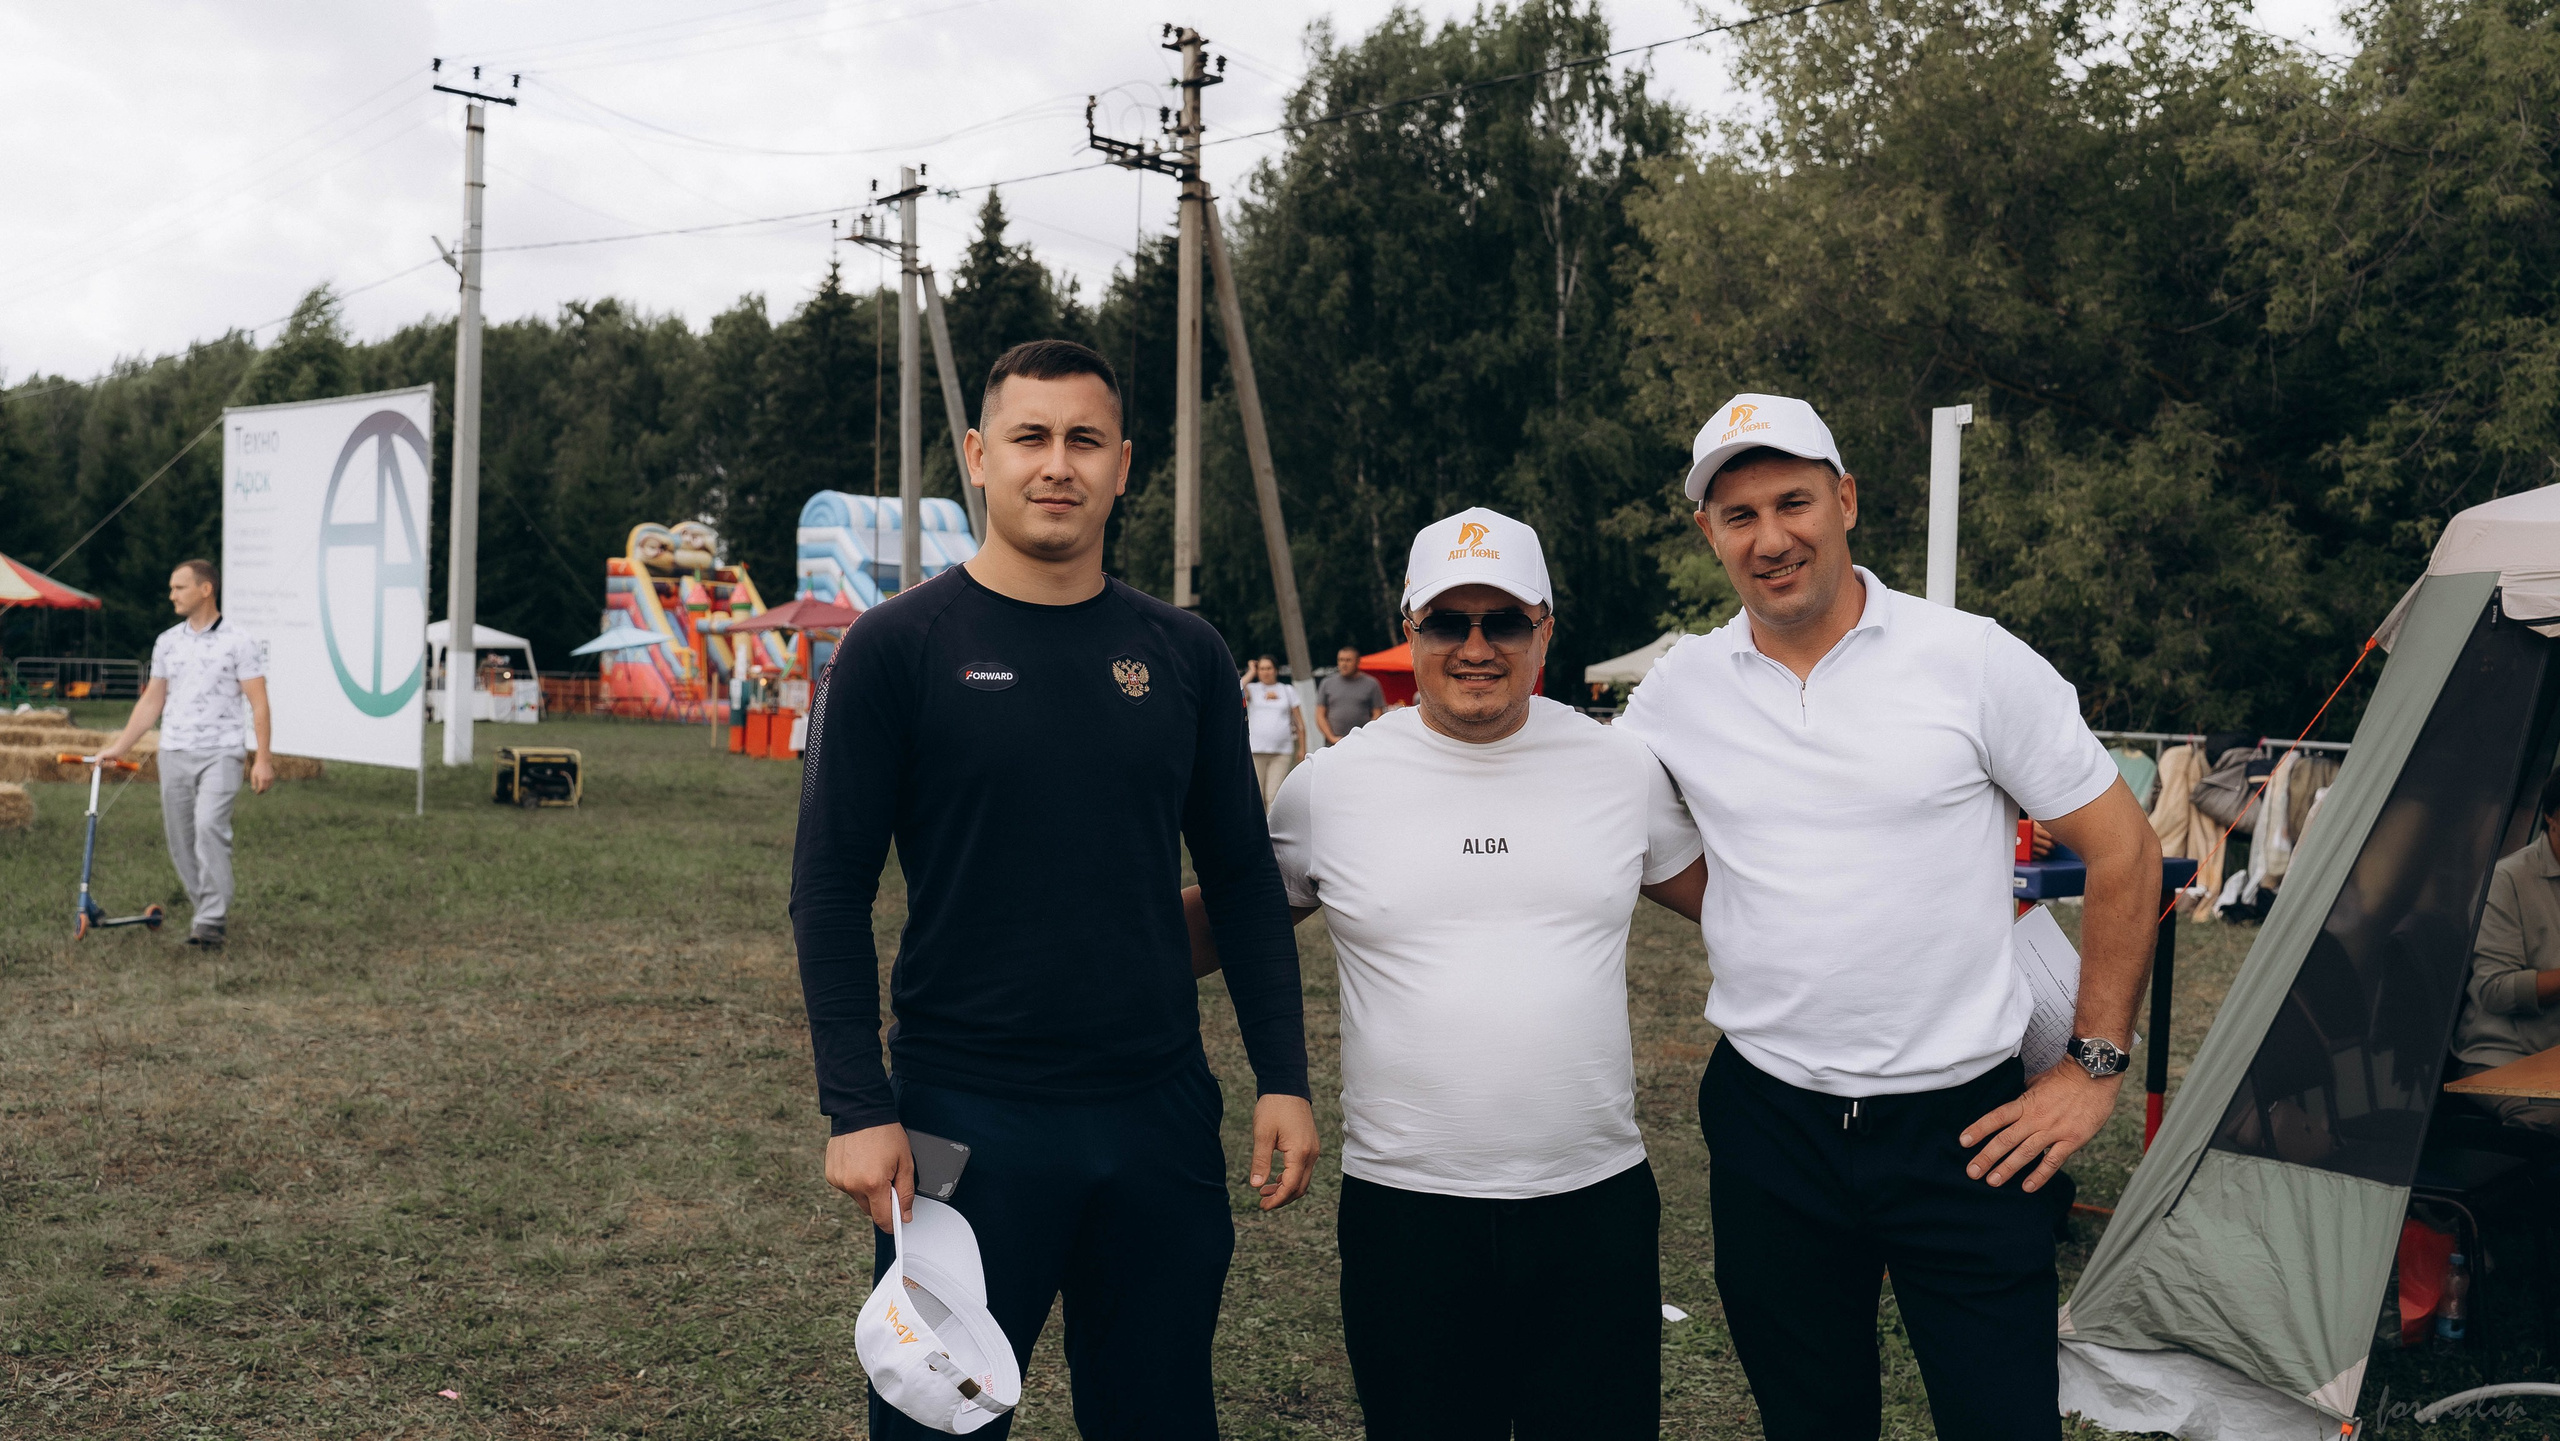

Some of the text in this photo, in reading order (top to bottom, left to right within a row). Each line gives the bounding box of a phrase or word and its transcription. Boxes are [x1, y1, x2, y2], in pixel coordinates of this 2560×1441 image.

[234, 426, 280, 454] Техно
[233, 466, 271, 501] Арск
[965, 670, 1014, 681] FORWARD
[1462, 837, 1509, 854] ALGA
